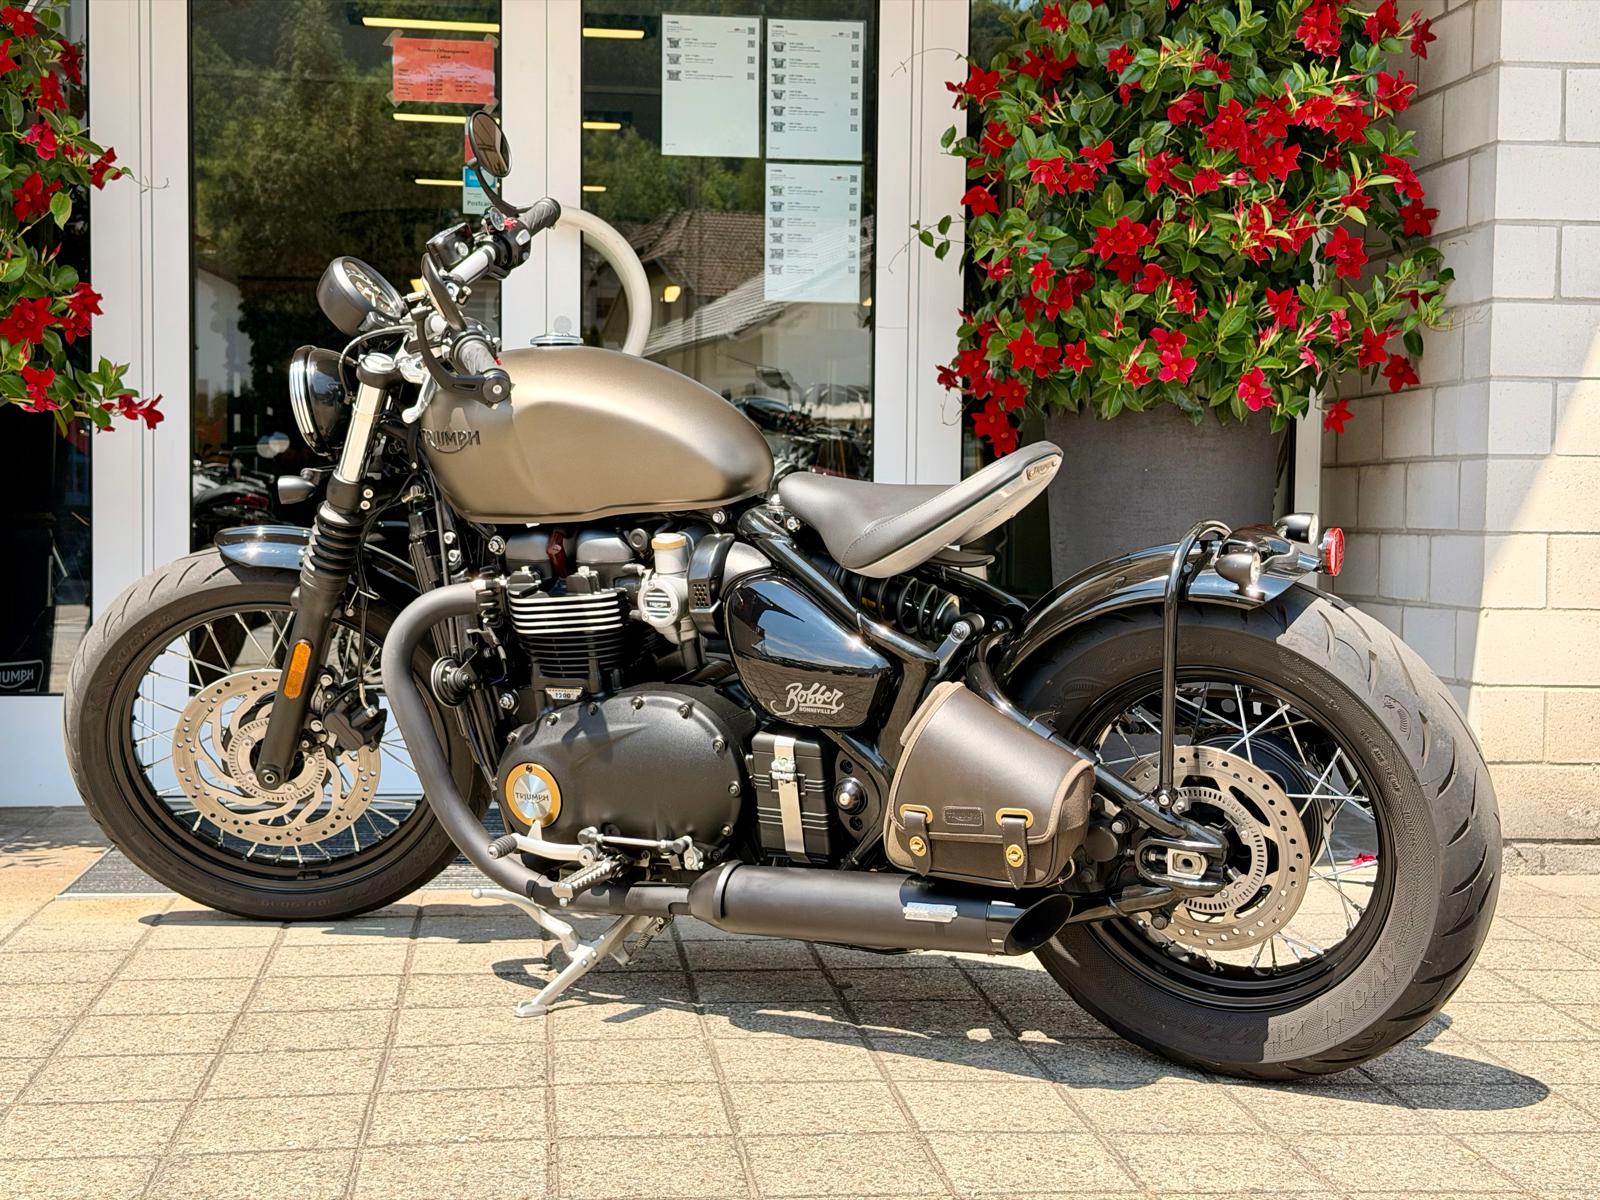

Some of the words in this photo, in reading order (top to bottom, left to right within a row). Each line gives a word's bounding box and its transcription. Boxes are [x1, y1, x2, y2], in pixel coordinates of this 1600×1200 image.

[770, 682, 844, 716] Bobber
[799, 706, 831, 715] BONNEVILLE
[515, 792, 549, 801] TRIUMPH
